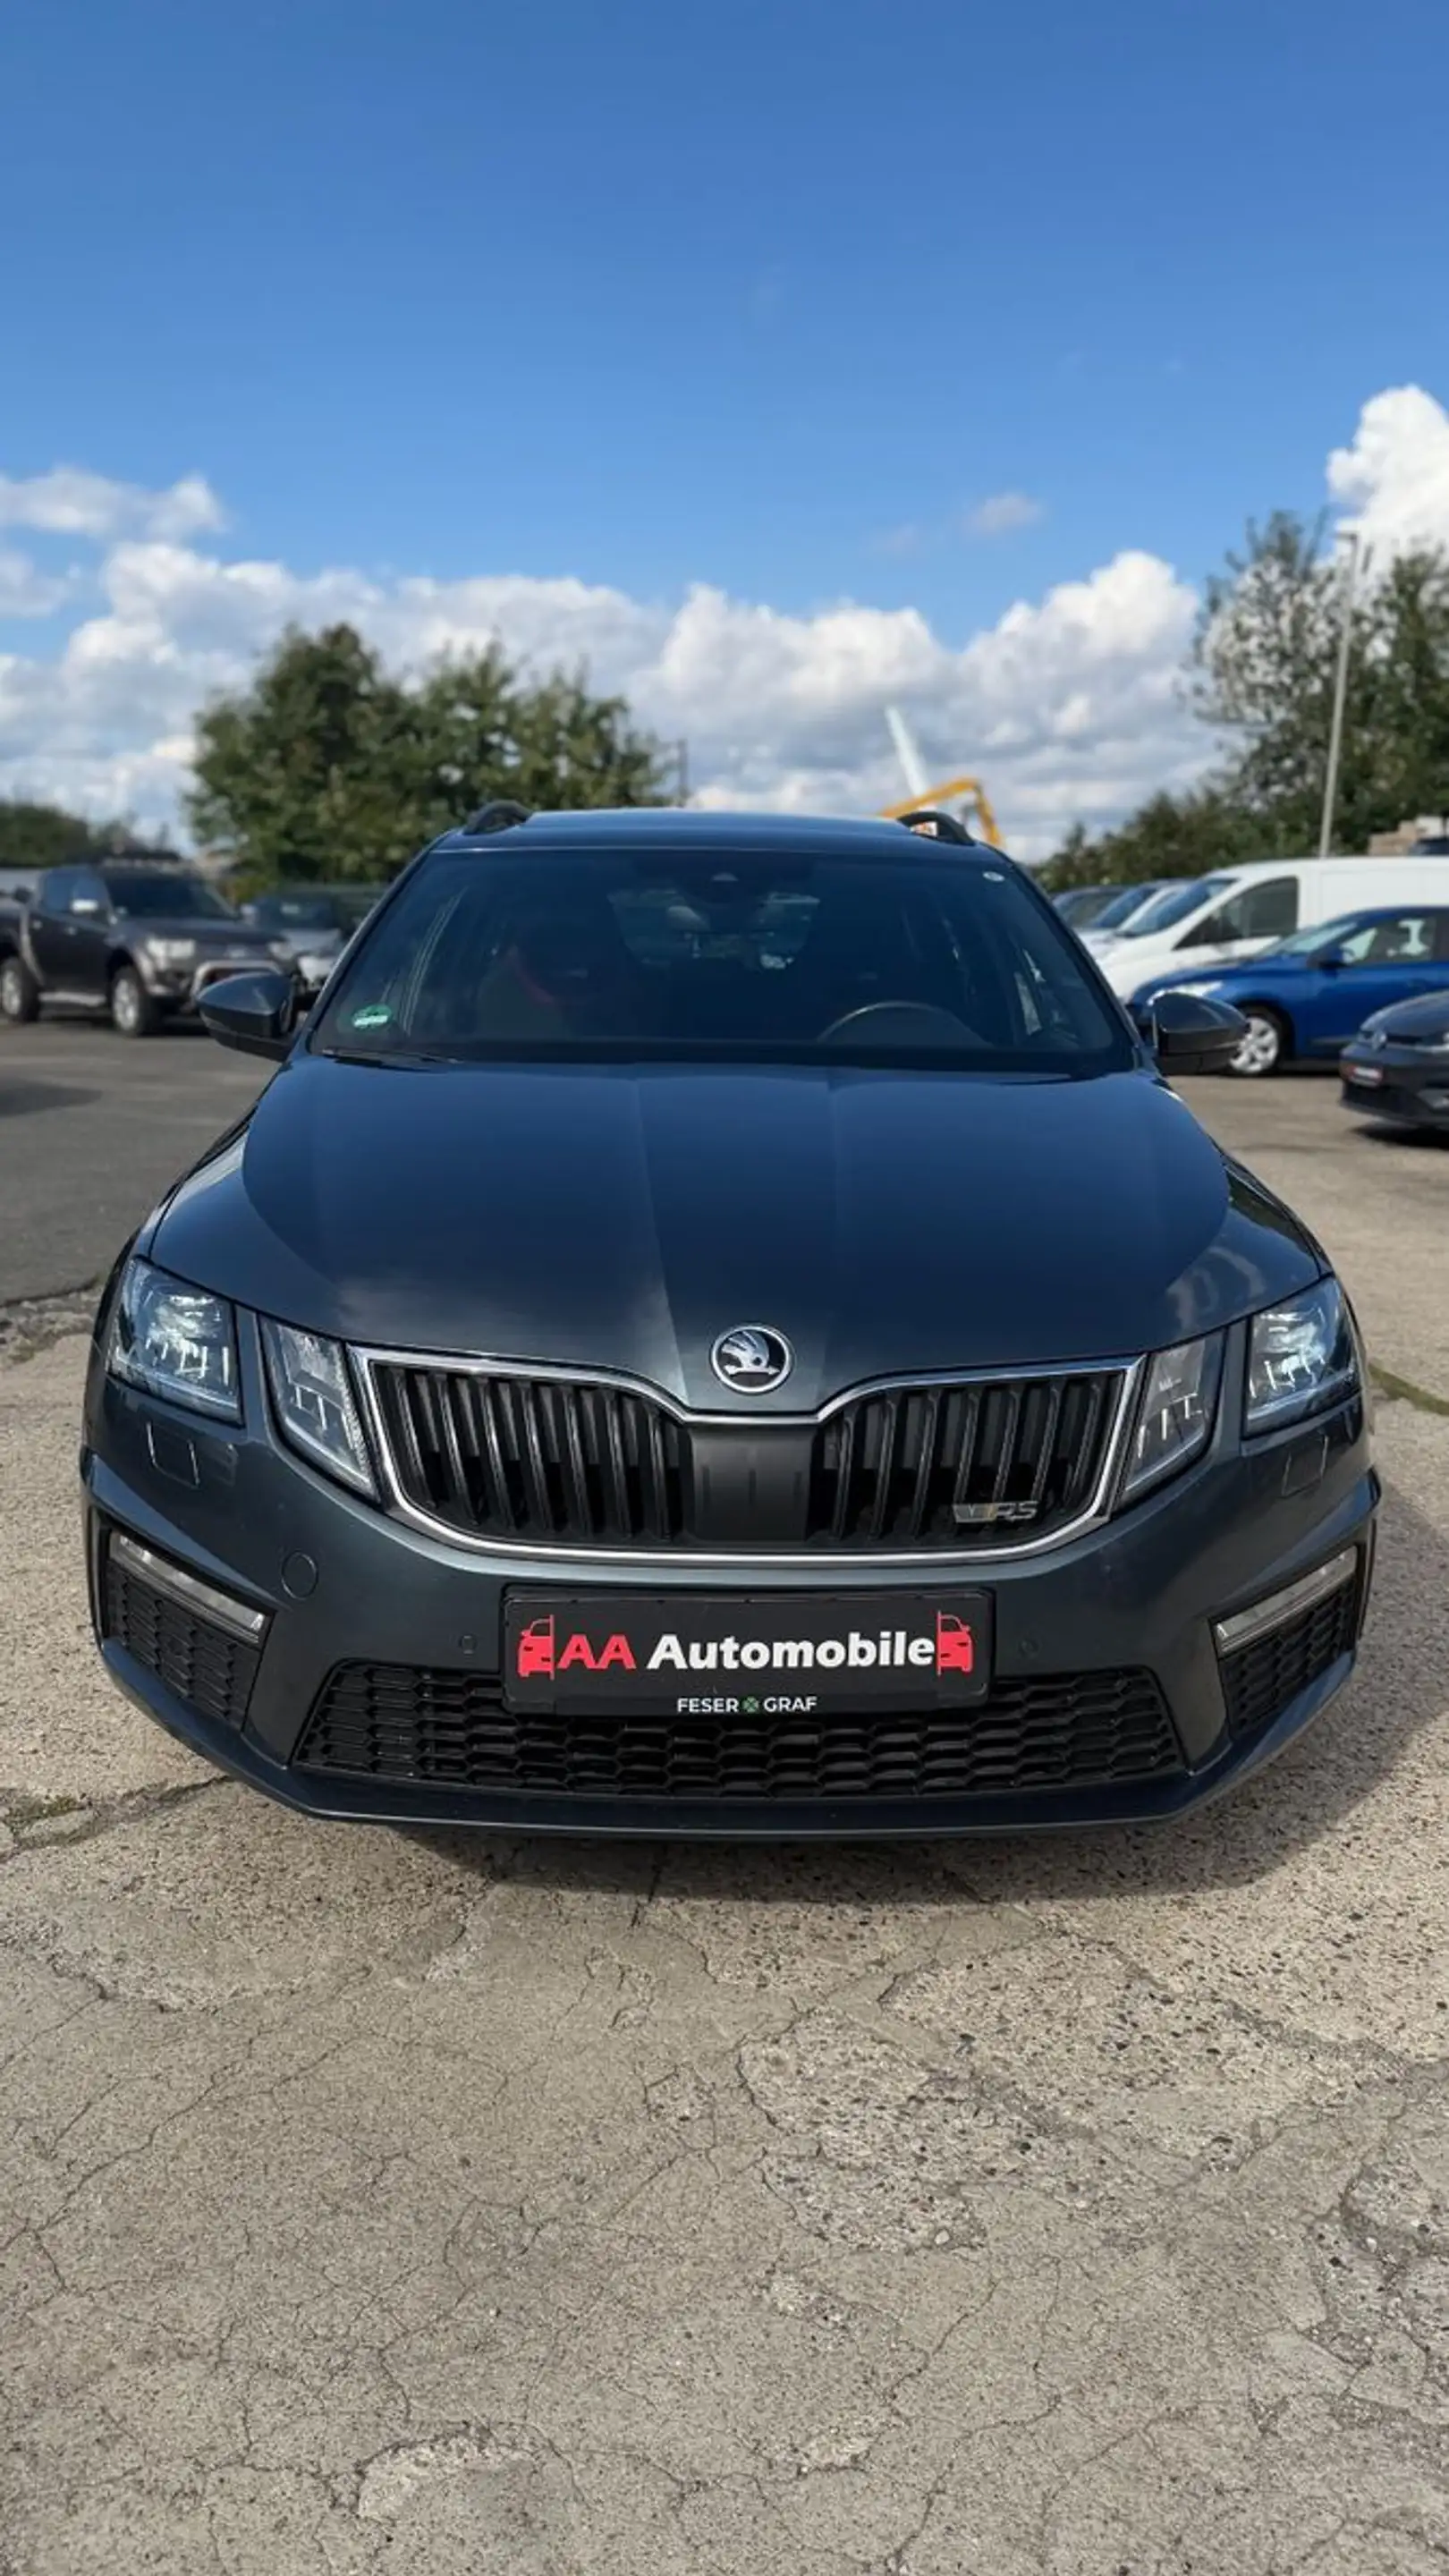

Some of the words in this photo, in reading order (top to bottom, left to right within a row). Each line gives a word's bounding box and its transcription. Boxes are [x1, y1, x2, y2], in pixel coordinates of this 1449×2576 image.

[556, 1633, 638, 1670] AA
[646, 1631, 936, 1671] Automobile
[676, 1697, 740, 1714] FESER
[763, 1695, 818, 1713] GRAF
